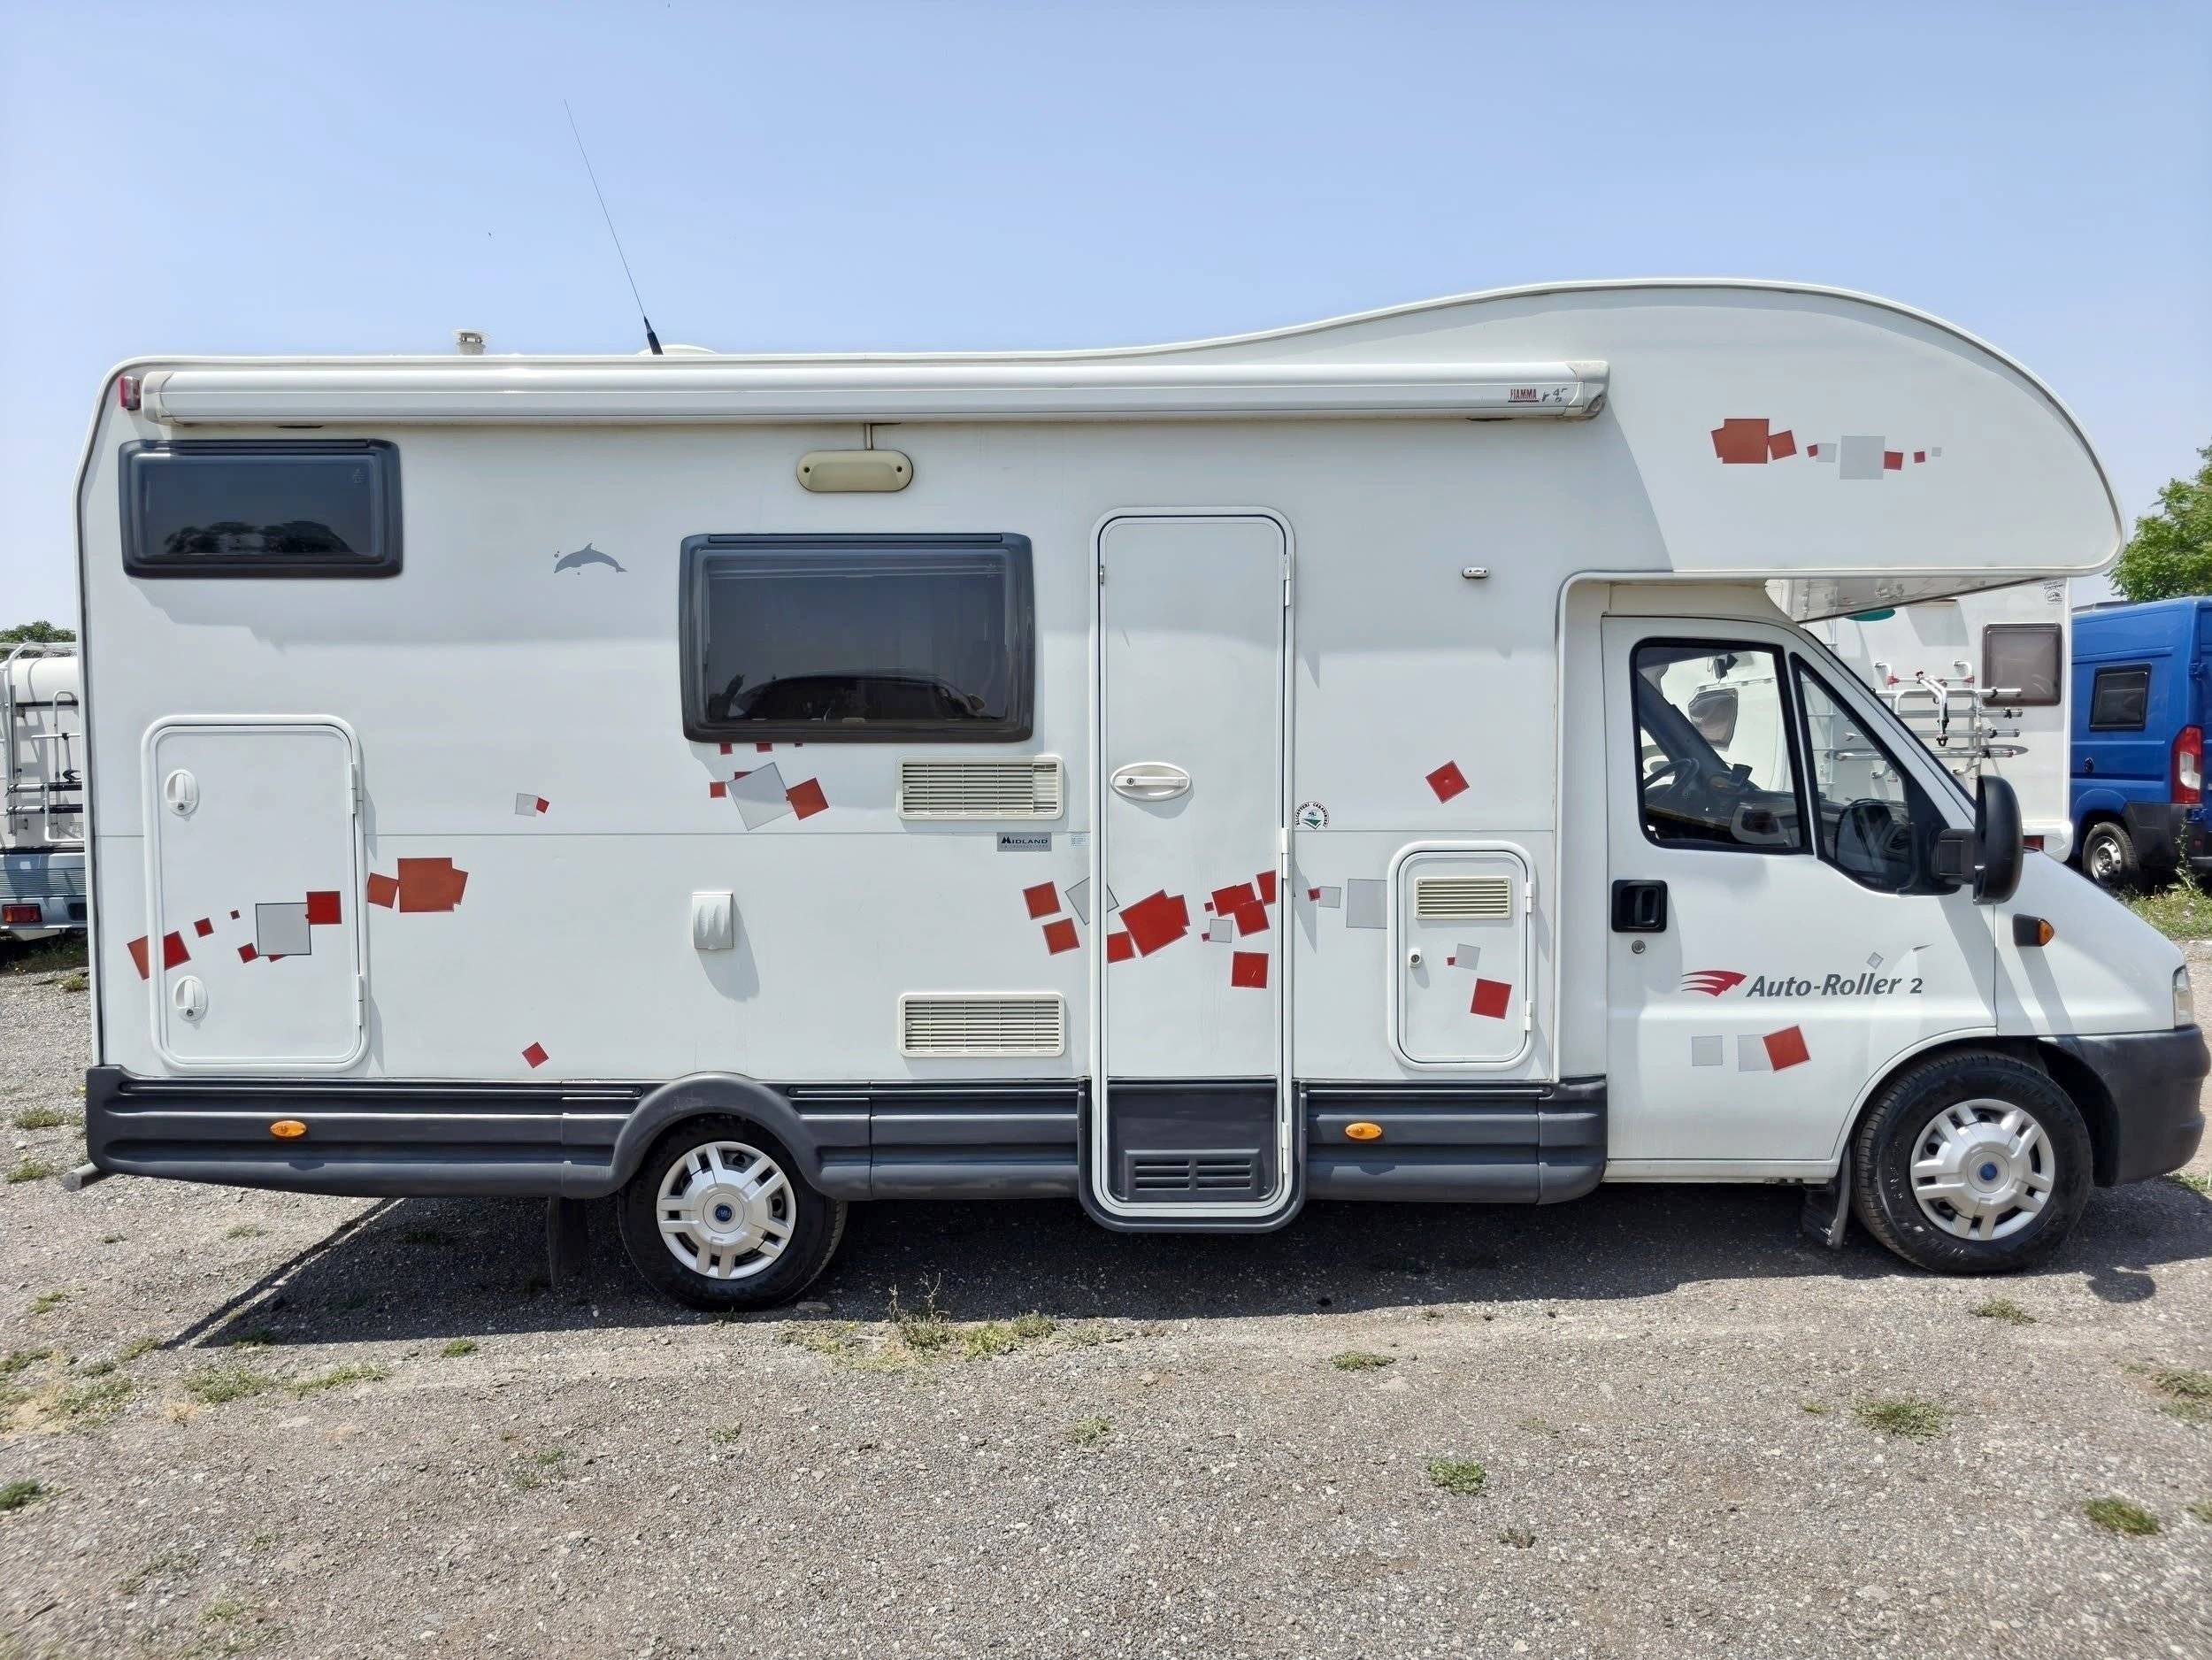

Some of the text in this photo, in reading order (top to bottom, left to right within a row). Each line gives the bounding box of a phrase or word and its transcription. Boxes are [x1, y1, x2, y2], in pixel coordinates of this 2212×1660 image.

[1509, 388, 1537, 400] FIAMMA
[1001, 835, 1048, 844] MIDLAND
[1745, 972, 1923, 997] Auto-Roller 2
